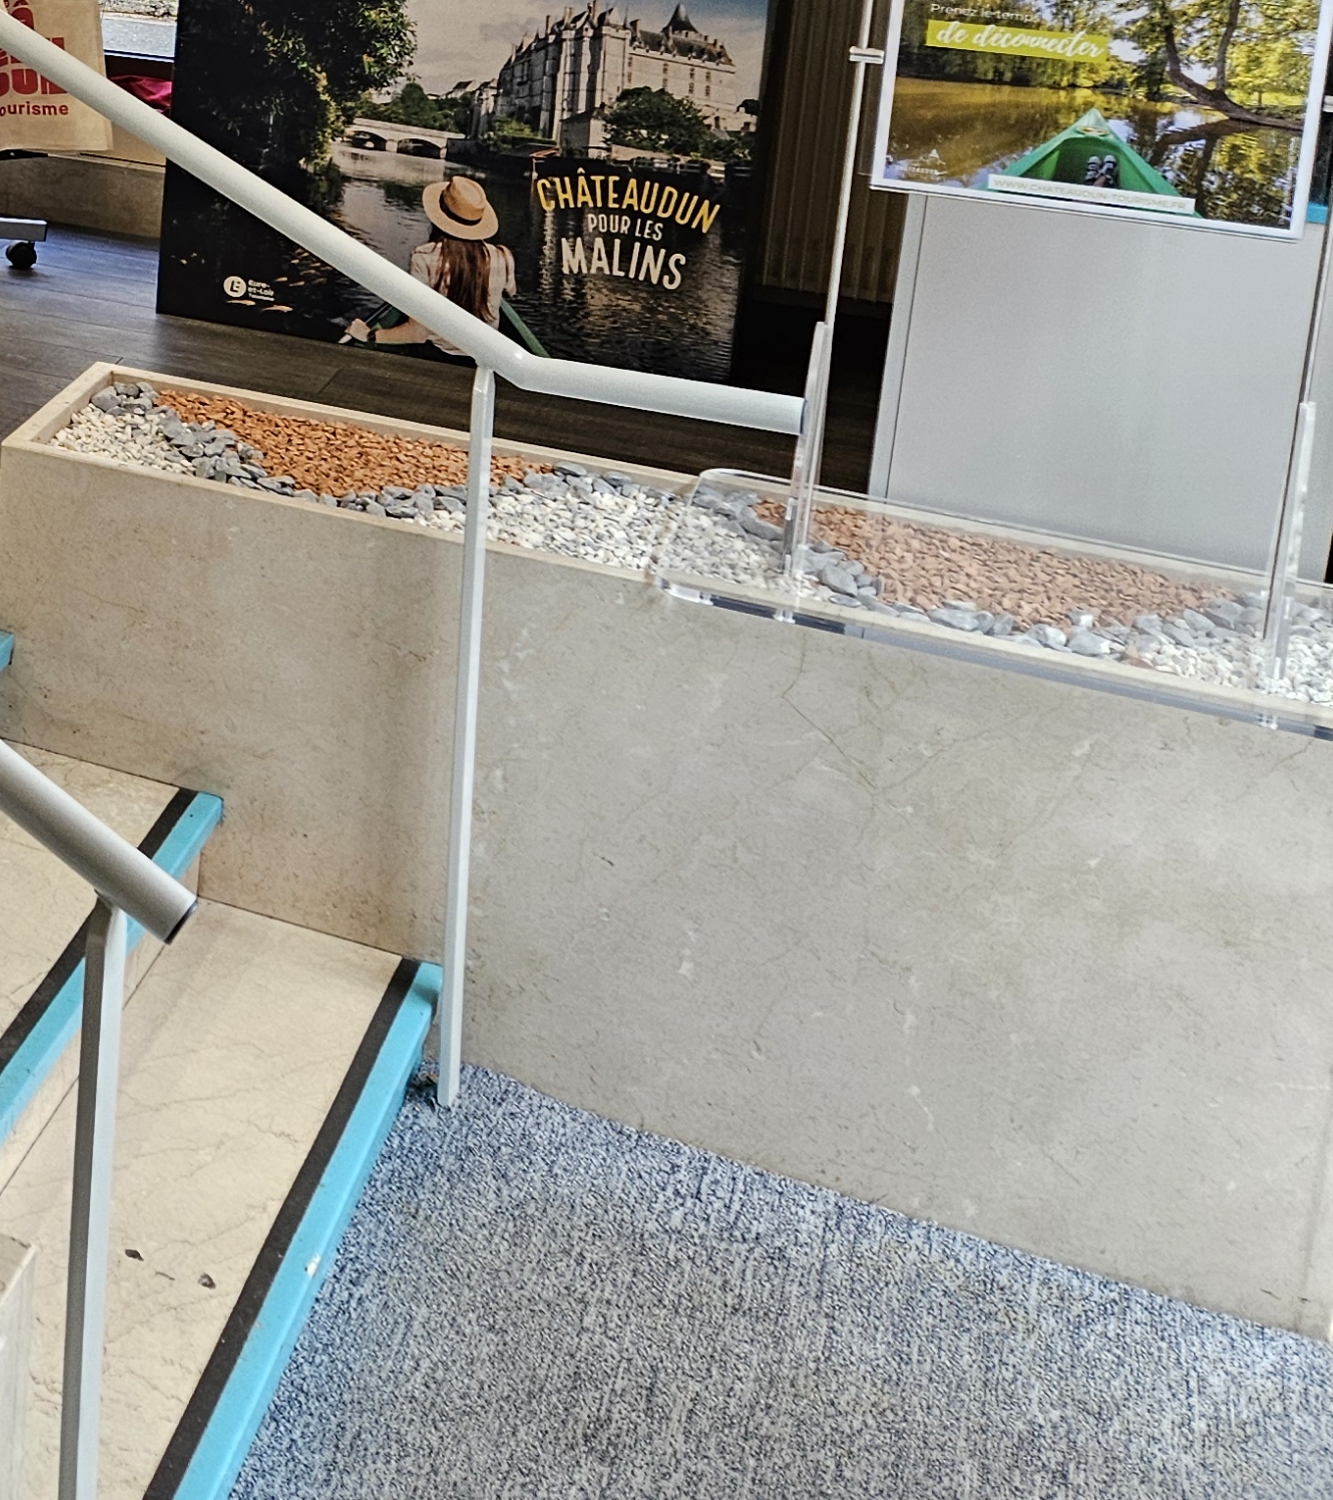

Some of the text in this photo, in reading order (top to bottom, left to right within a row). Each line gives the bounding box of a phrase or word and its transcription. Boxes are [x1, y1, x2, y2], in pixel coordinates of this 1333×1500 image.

[930, 3, 978, 17] Prenez
[981, 7, 993, 19] le
[935, 20, 1105, 58] de déconnecter
[536, 167, 721, 234] CHÂTEAUDUN
[587, 213, 664, 241] POUR LES
[561, 236, 686, 291] MALINS
